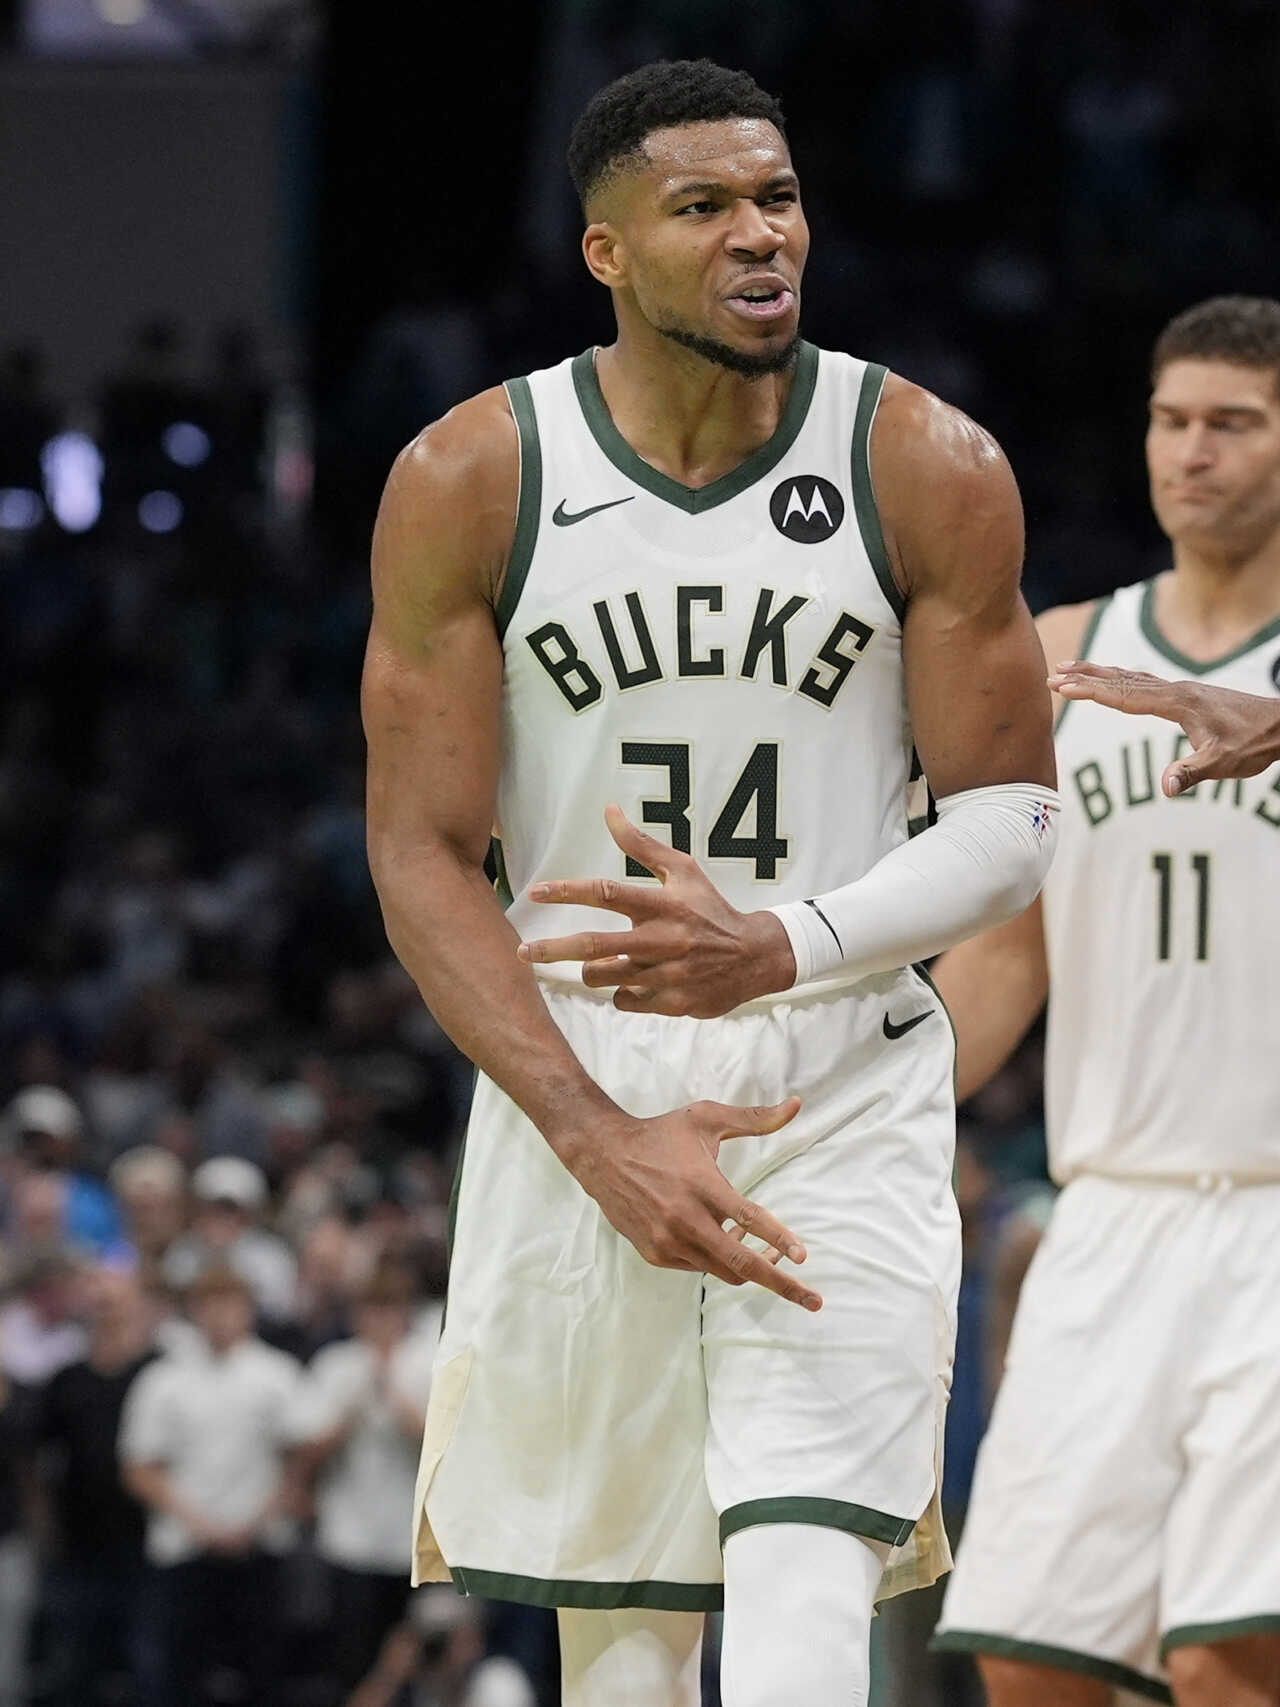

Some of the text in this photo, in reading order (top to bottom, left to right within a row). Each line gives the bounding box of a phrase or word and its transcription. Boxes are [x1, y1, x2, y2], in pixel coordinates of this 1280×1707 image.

[524, 585, 879, 714] BUCKS
[618, 738, 789, 882] 34
[1151, 852, 1210, 962] 11
